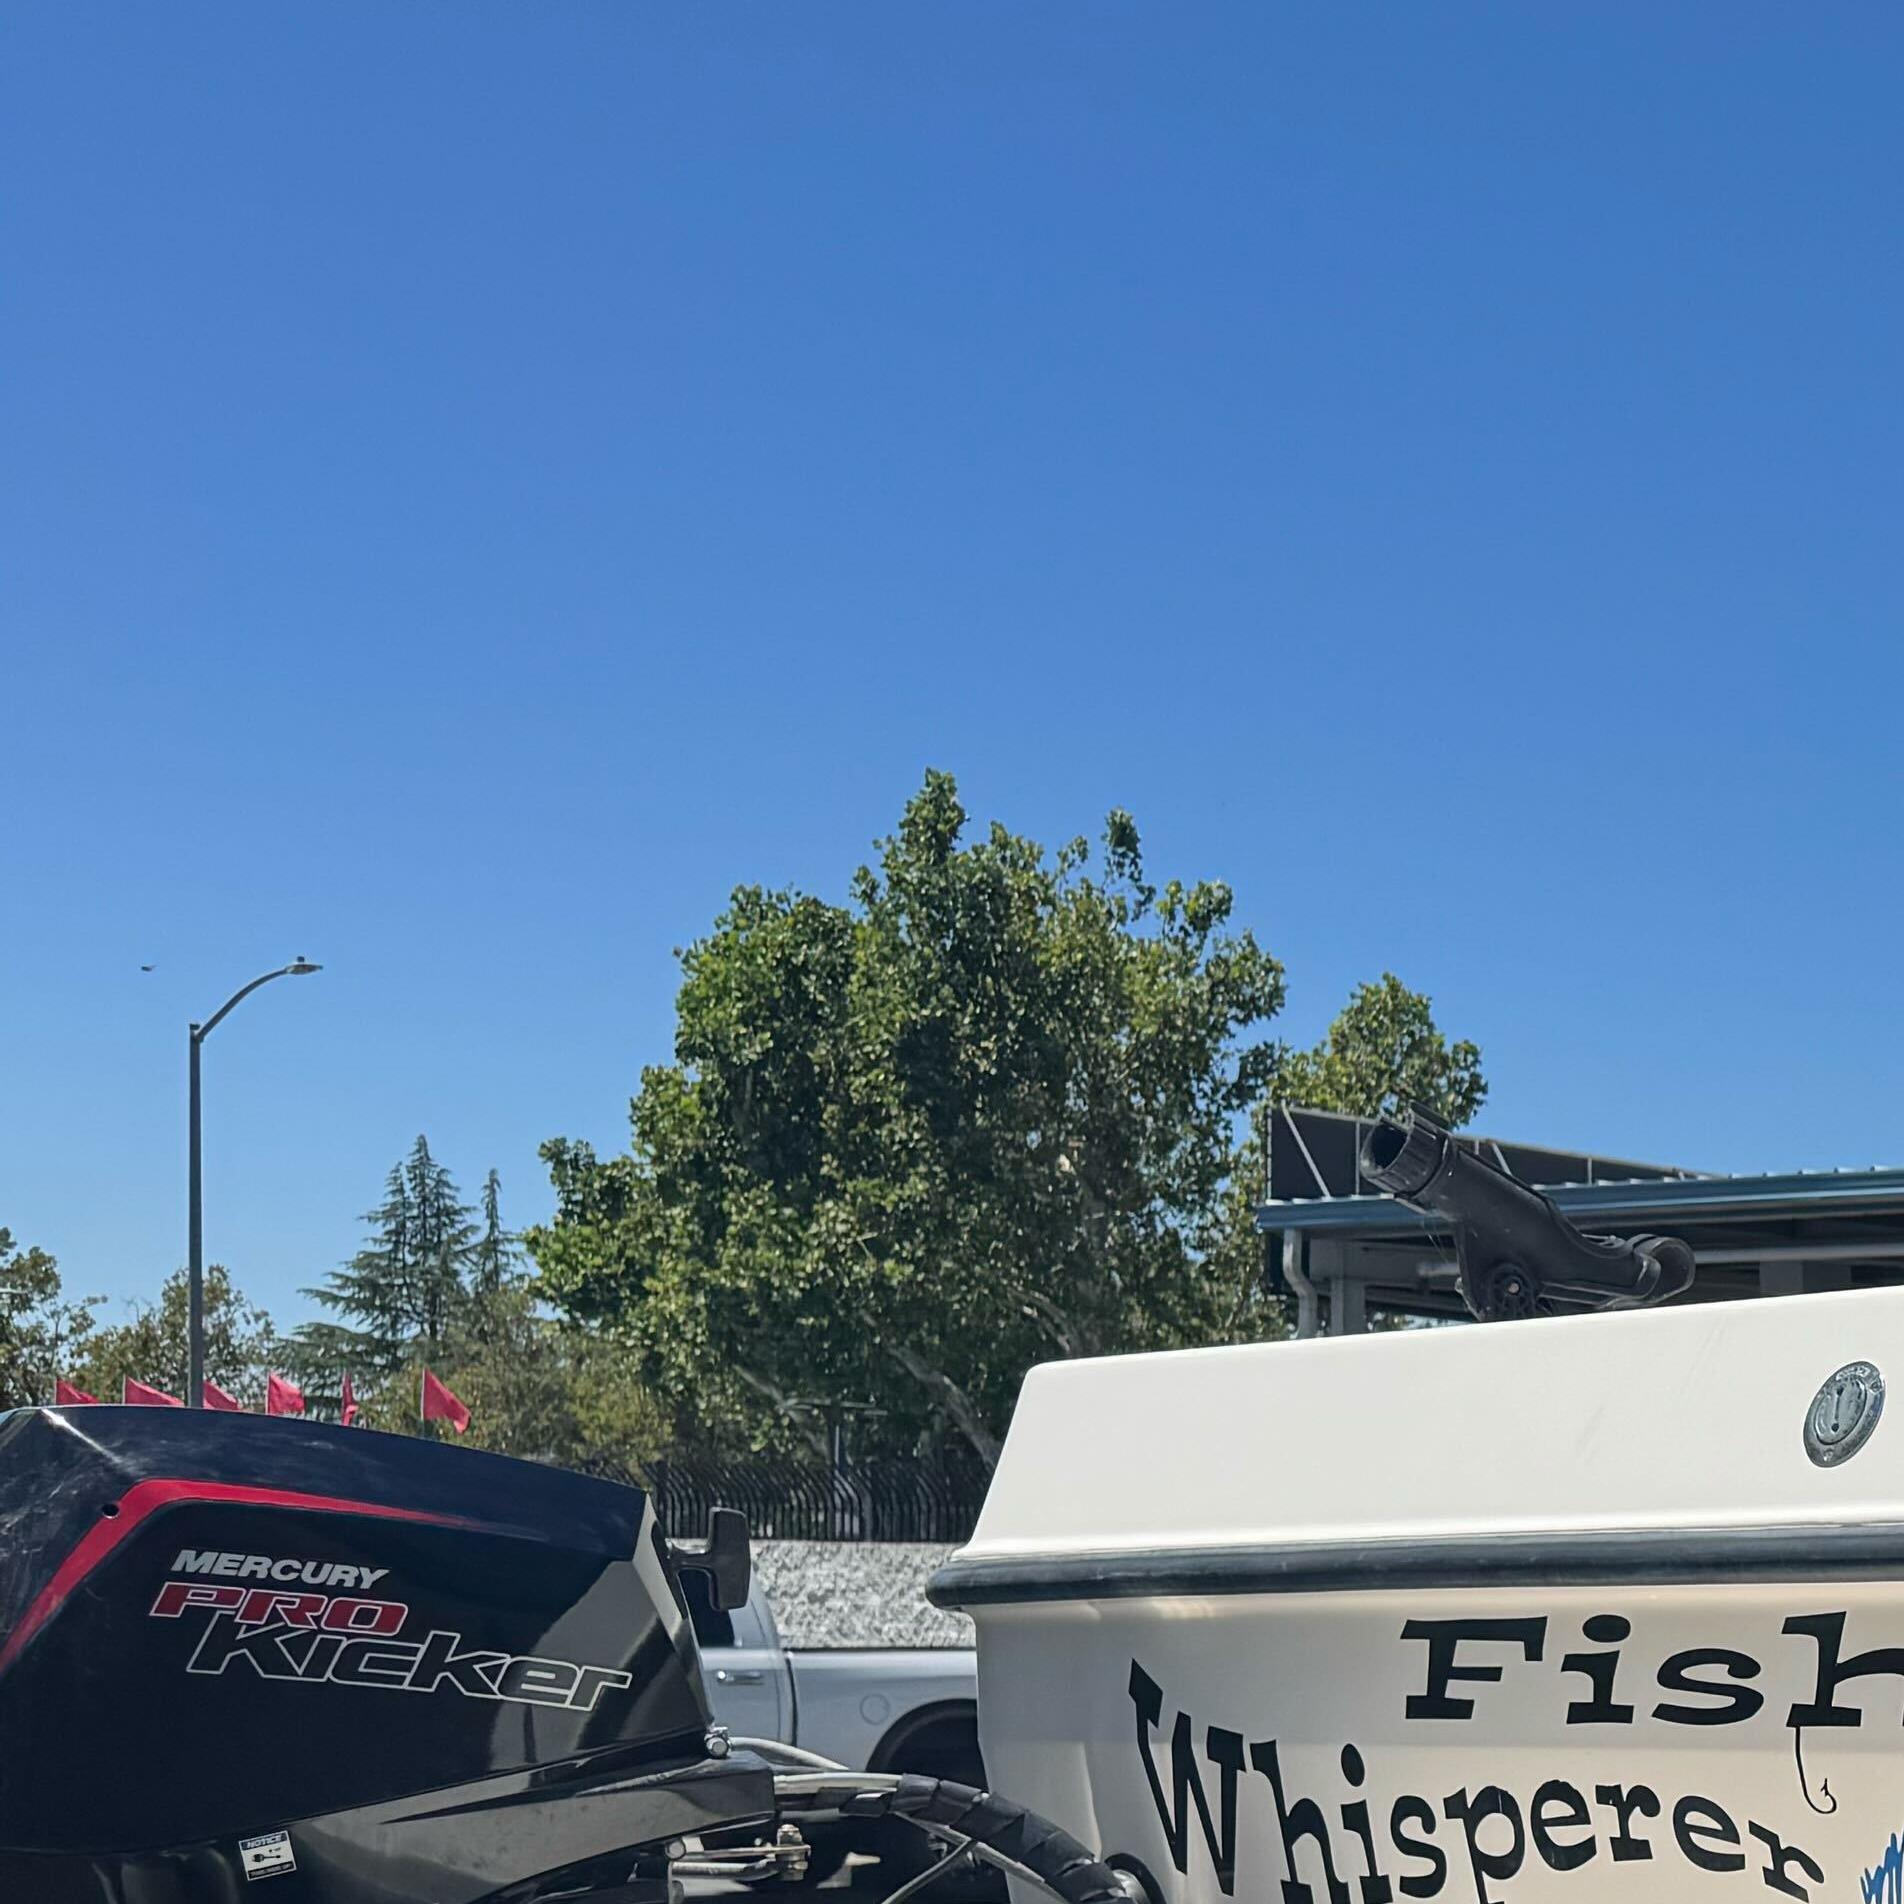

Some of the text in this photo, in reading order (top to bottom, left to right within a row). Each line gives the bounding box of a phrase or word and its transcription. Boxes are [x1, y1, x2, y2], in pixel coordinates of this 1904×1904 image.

[170, 1549, 391, 1592] MERCURY
[149, 1580, 409, 1637] PRO
[186, 1611, 634, 1712] Kicker
[245, 1834, 283, 1849] NOTICE
